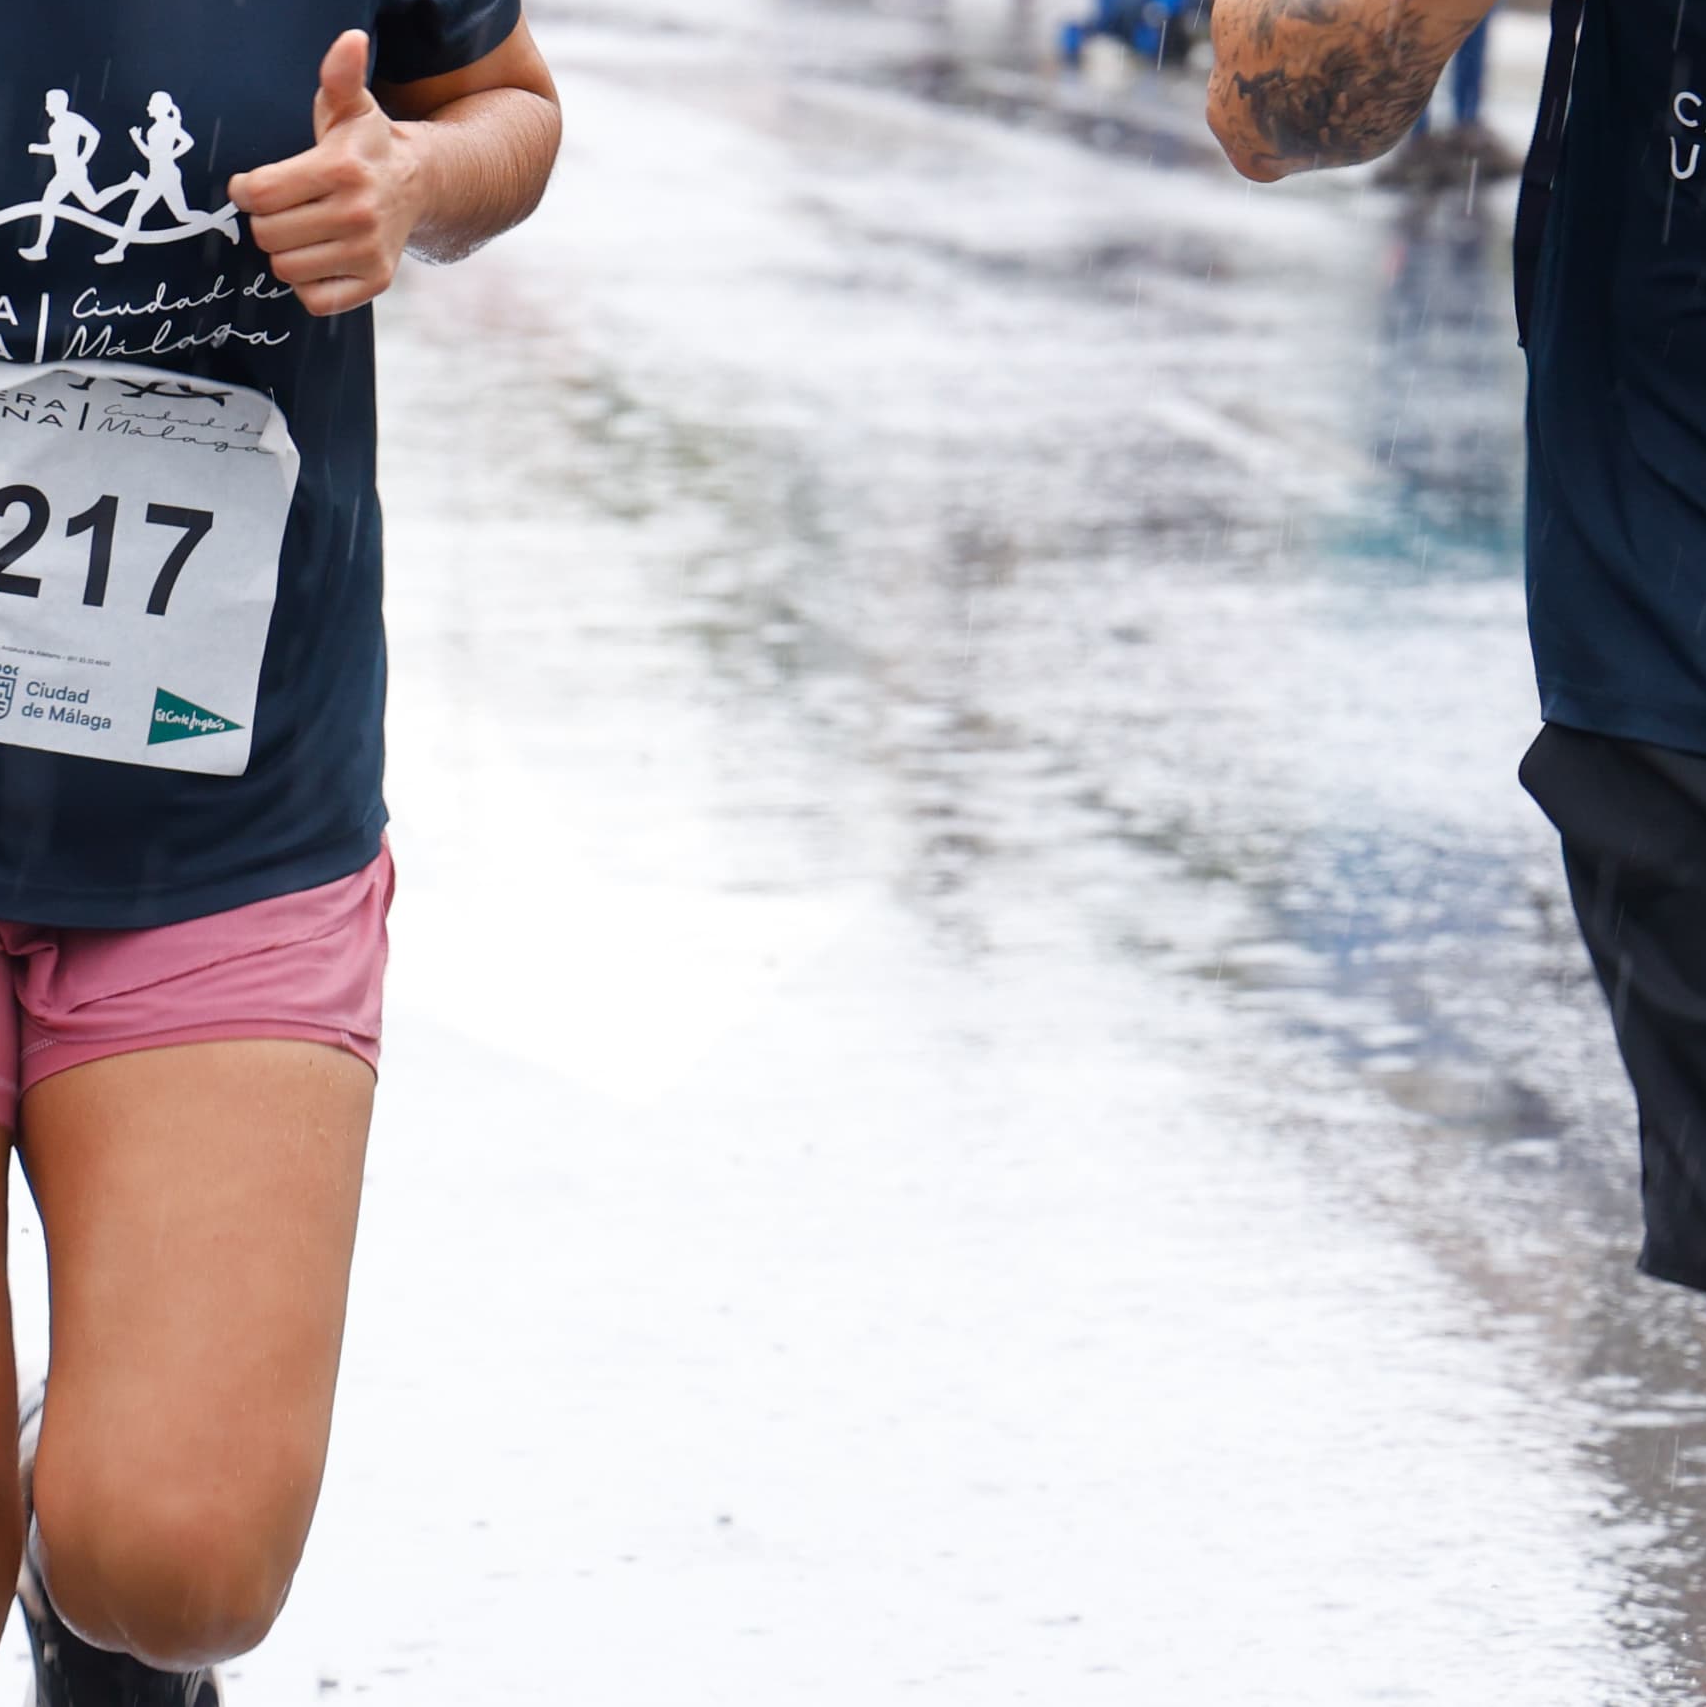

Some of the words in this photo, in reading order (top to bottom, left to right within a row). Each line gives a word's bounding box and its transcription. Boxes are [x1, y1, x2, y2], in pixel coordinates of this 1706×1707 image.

[72, 274, 235, 319] Ciudad
[61, 319, 291, 360] Málaga
[97, 417, 276, 456] Málaga
[26, 681, 90, 704] Ciudad
[21, 702, 44, 718] de
[48, 705, 112, 731] Málaga
